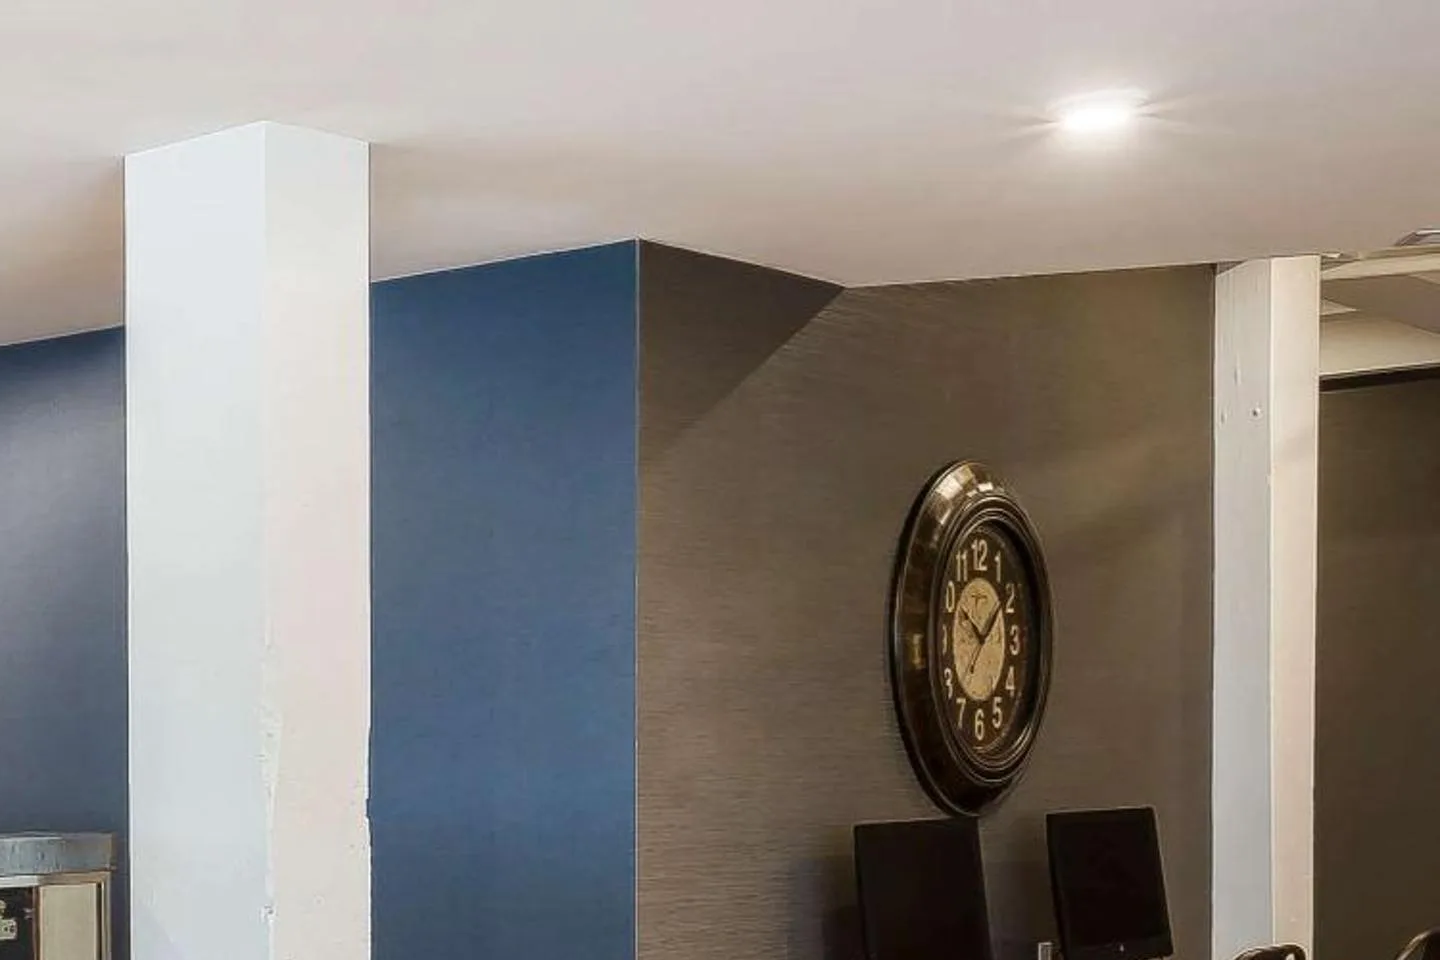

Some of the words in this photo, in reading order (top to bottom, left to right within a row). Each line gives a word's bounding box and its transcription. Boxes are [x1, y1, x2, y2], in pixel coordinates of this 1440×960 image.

[956, 550, 968, 582] 11
[971, 539, 988, 571] 12
[994, 550, 1001, 582] 1
[946, 581, 955, 613] 0
[1006, 583, 1014, 613] 2
[1009, 625, 1020, 655] 3
[1005, 666, 1014, 697] 4
[956, 698, 966, 729] 7
[975, 709, 985, 741] 6
[992, 697, 1002, 729] 5
